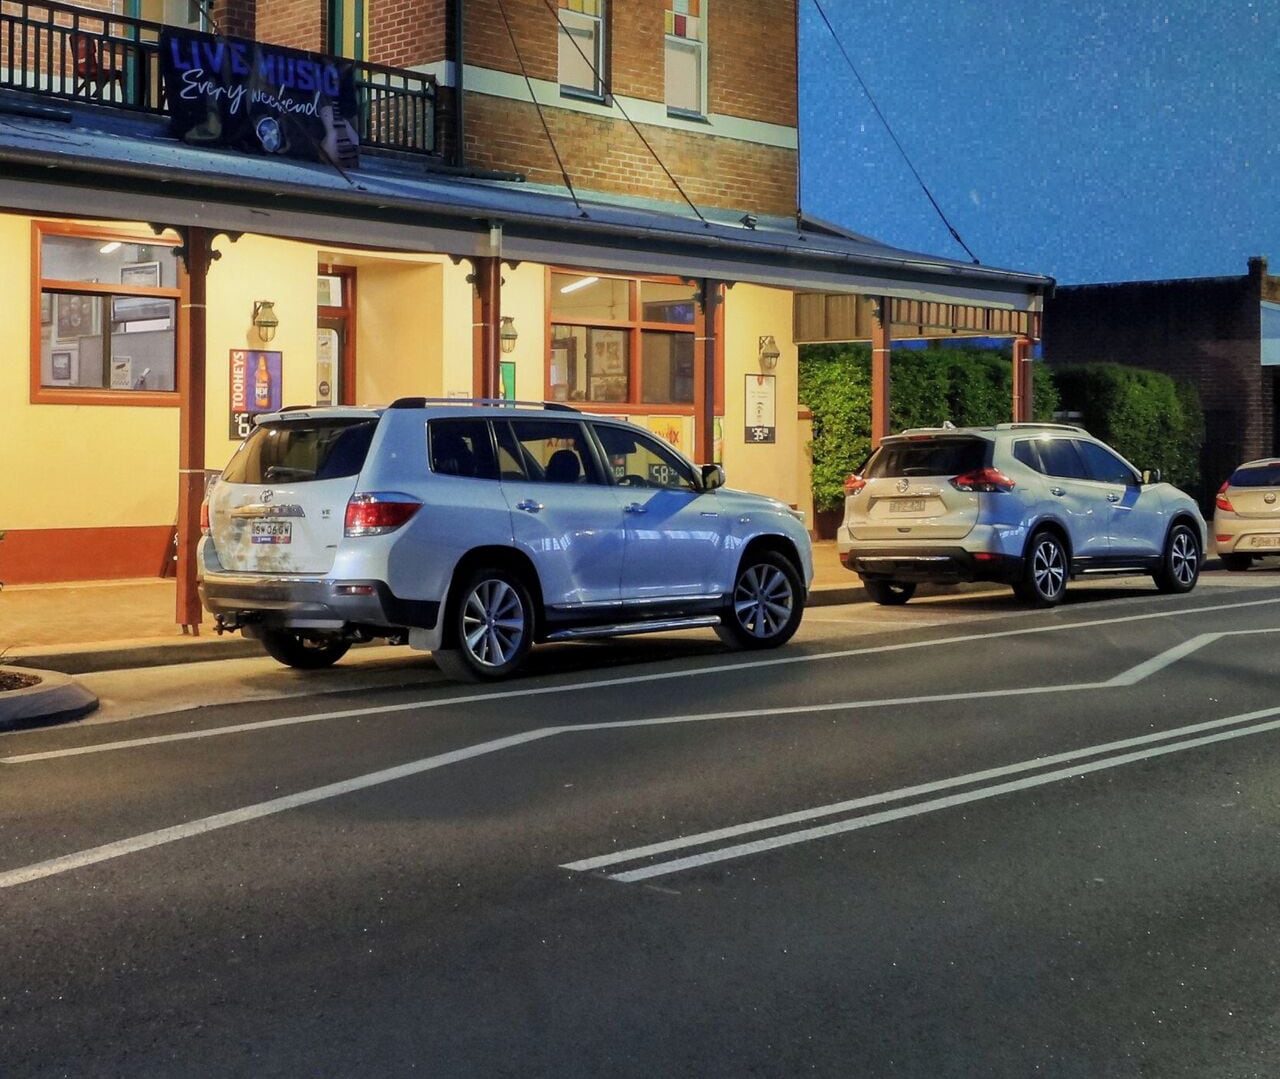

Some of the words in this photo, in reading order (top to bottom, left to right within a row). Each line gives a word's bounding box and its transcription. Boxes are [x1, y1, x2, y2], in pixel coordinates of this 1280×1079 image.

[171, 37, 249, 74] LIVE
[255, 50, 340, 97] MUSIC
[179, 68, 247, 115] Every
[251, 83, 321, 118] weekend
[232, 351, 244, 408] TOOHEYS
